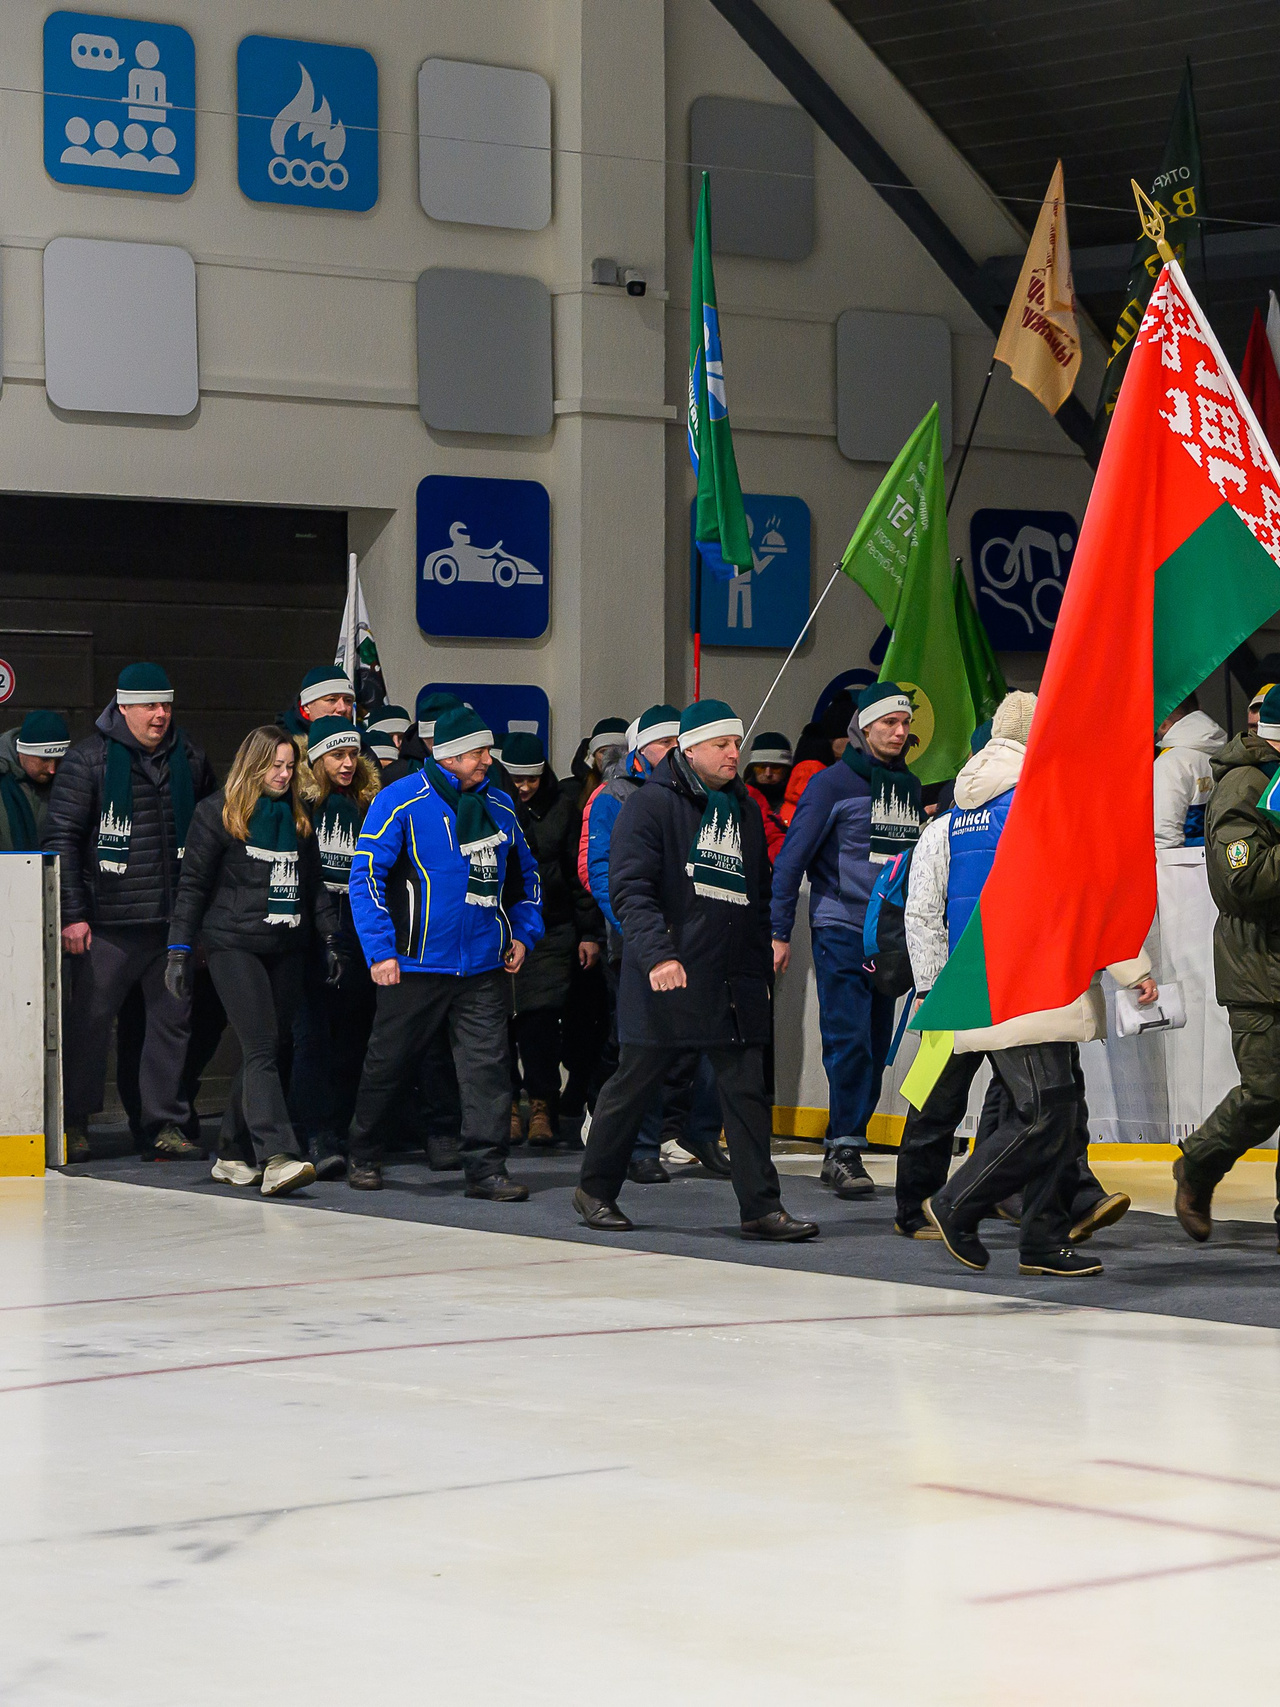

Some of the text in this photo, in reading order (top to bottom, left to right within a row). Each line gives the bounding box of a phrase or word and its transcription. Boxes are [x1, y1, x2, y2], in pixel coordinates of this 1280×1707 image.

[865, 539, 903, 586] Республик
[875, 824, 917, 834] ХРАНИТЕЛИ
[320, 852, 354, 863] РАНИТЕЛ
[327, 859, 346, 868] ЛЕСА
[715, 861, 737, 872] ЛЕСА
